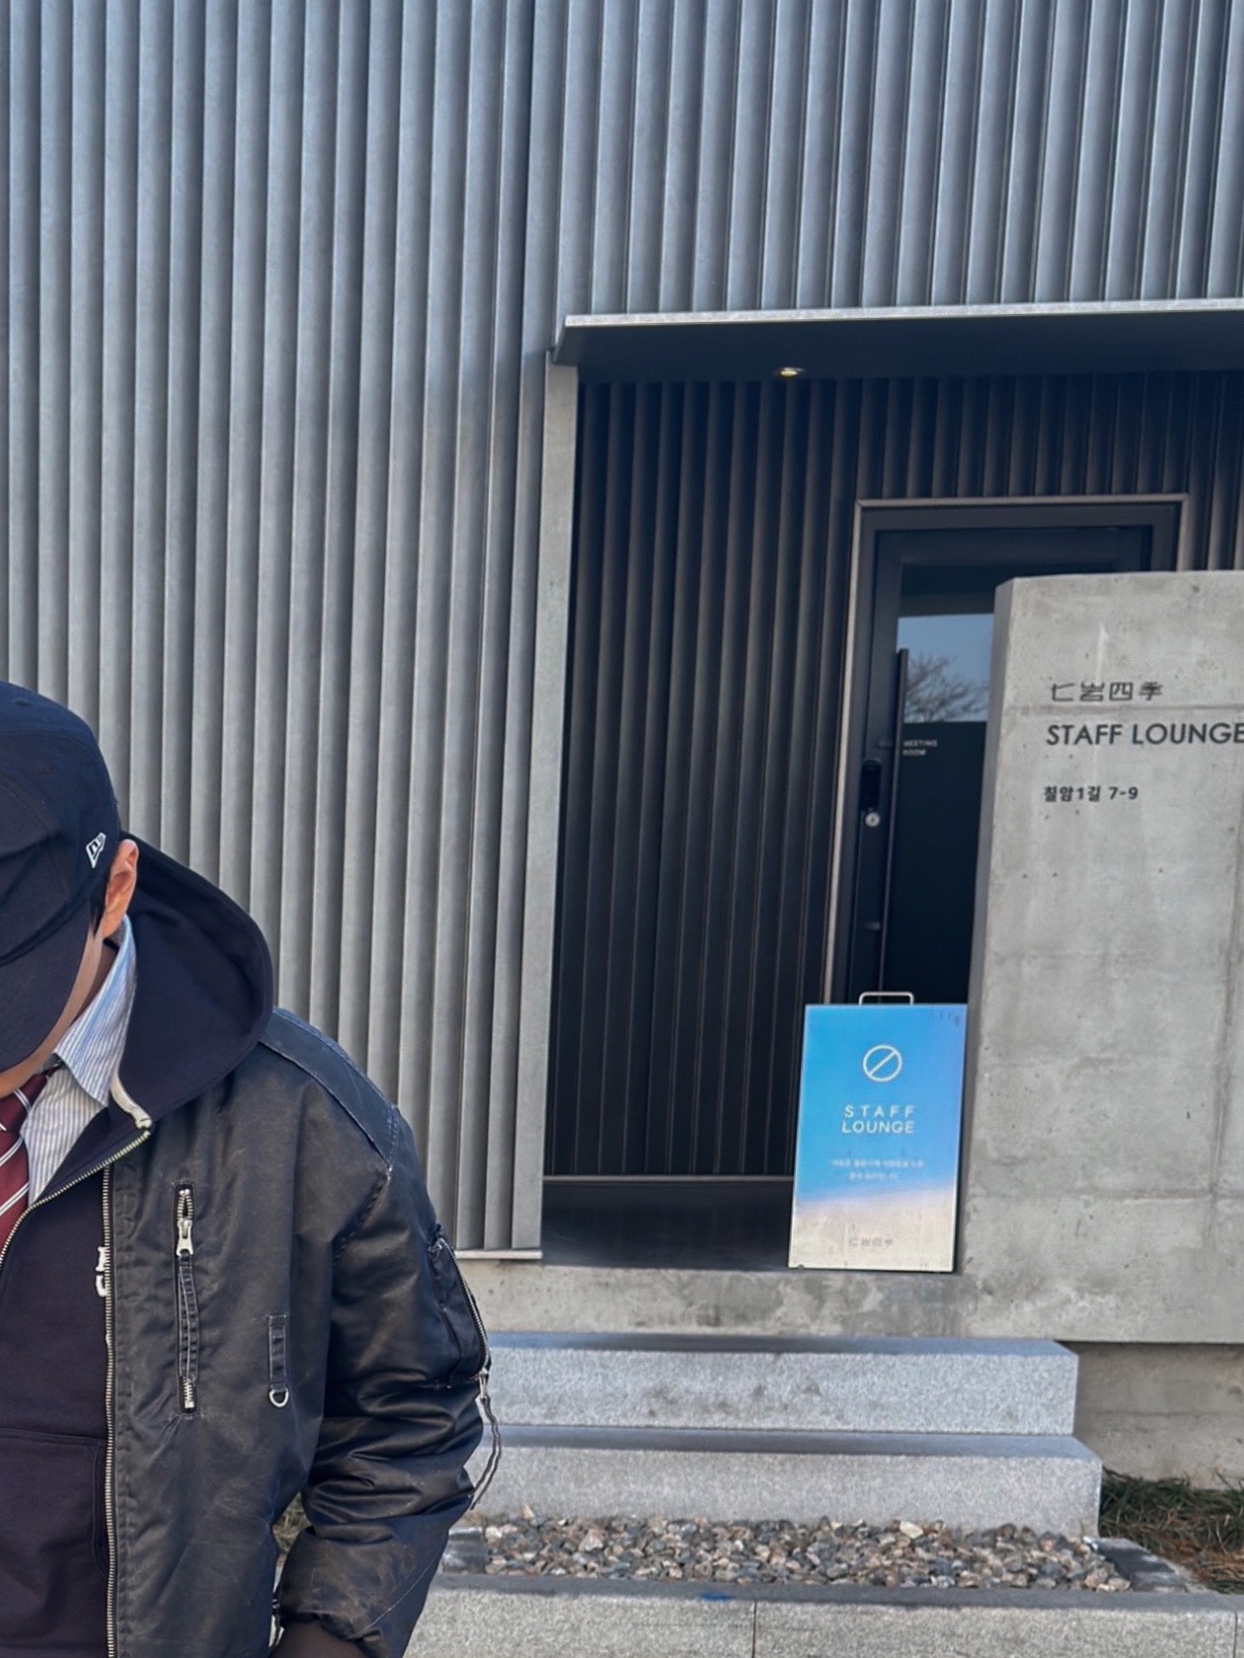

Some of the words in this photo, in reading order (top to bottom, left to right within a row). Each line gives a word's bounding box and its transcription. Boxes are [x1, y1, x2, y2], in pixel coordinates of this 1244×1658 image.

[1046, 723, 1123, 745] STAFF
[1132, 722, 1244, 744] LOUNGE
[1044, 786, 1101, 803] 칠암1길
[1109, 786, 1138, 800] 7-9
[844, 1104, 915, 1118] STAFF
[841, 1120, 915, 1134] LOUNGE
